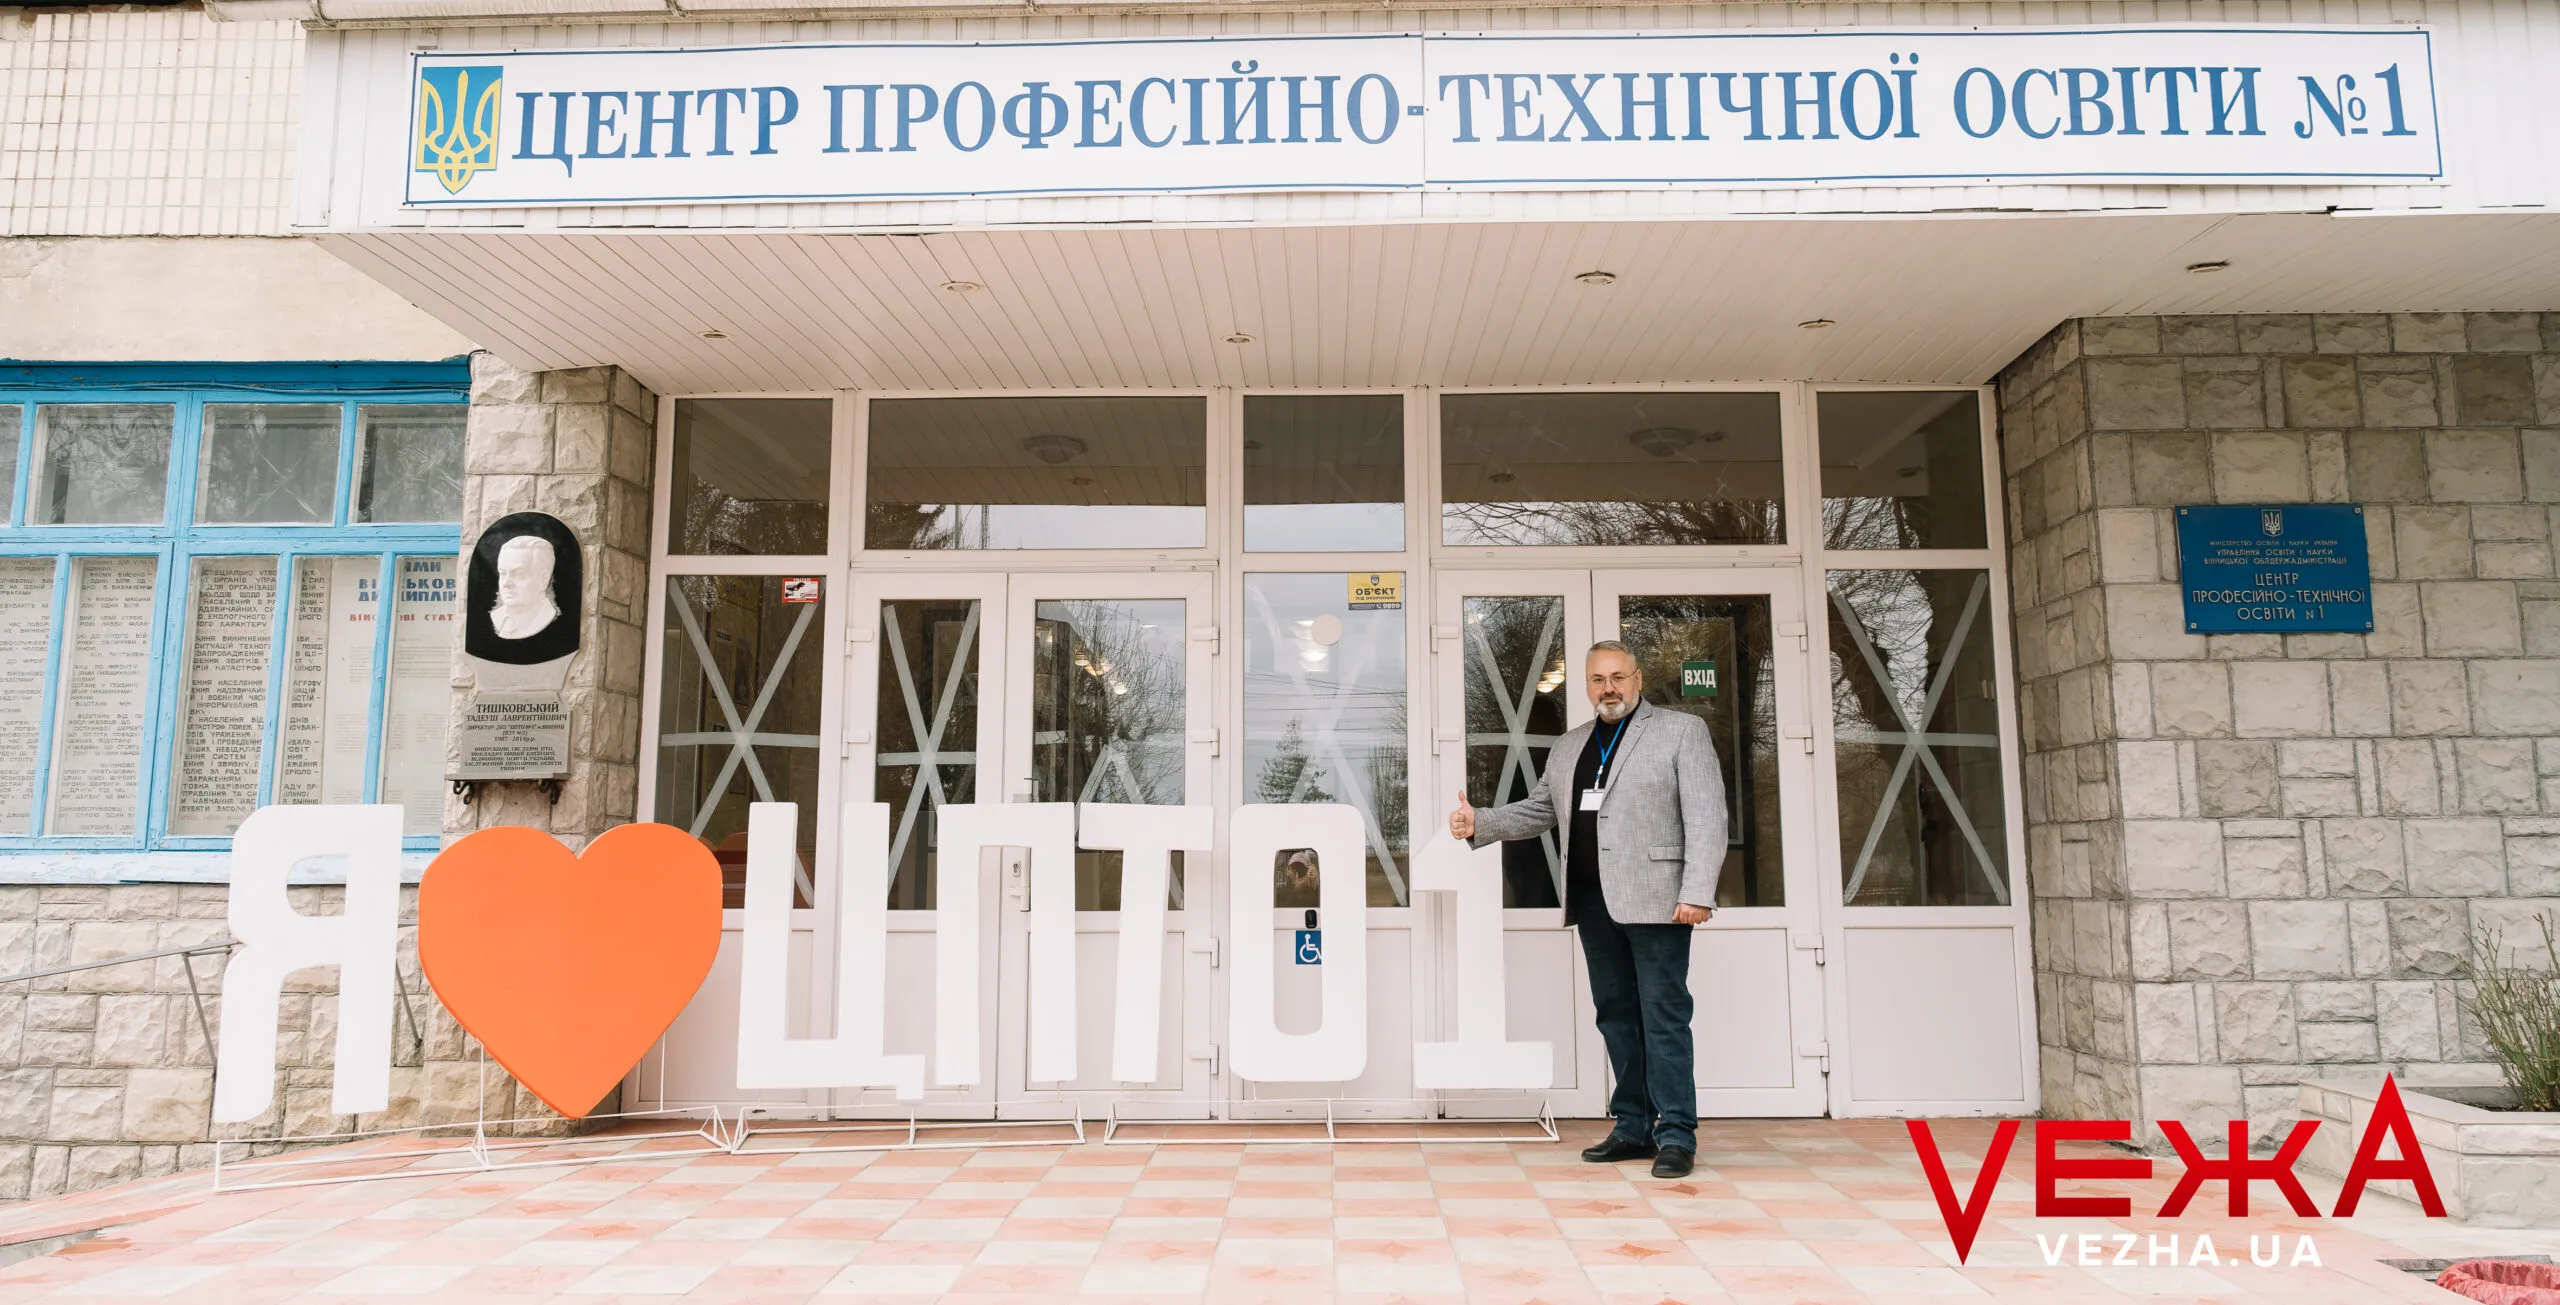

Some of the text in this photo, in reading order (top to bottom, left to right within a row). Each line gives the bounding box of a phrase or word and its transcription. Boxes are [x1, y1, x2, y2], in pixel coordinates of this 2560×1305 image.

[512, 86, 799, 178] ЦЕНТР
[1953, 66, 2266, 140] ОСВІТИ
[2204, 557, 2248, 565] ВІННИЦЬКОЇ
[2255, 573, 2299, 587] ЦЕНТР
[2237, 608, 2295, 620] ОСВІТИ
[1684, 670, 1716, 688] ВХІД
[476, 702, 559, 713] ТИШКОВСЬКИЙ
[501, 713, 567, 721] ЛАВРЕНТІЙОВИЧ
[214, 803, 404, 1123] Я
